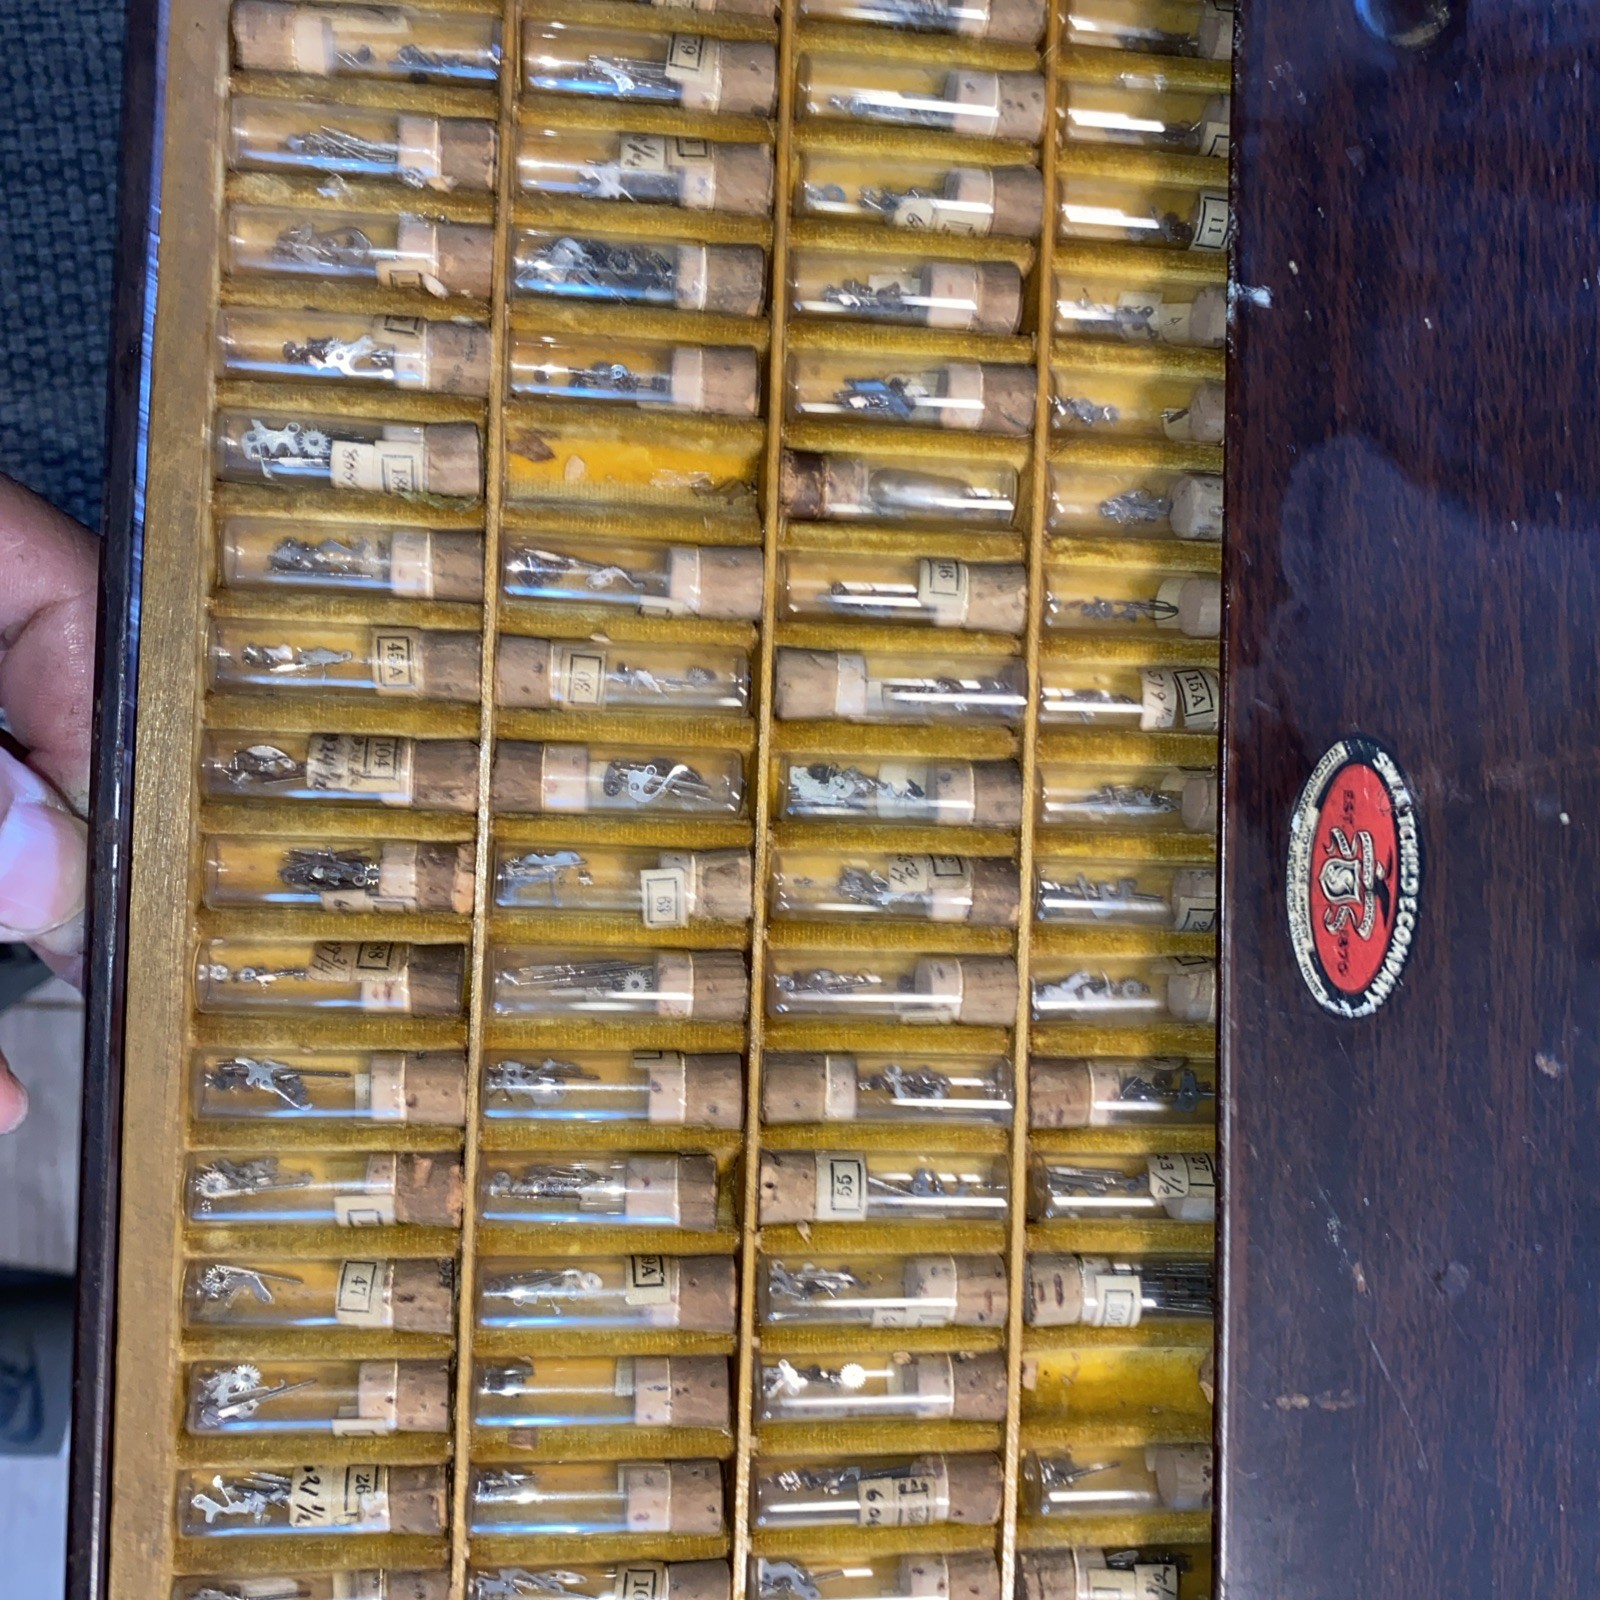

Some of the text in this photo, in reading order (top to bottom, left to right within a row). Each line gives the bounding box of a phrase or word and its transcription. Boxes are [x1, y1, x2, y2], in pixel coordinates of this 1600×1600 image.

[1208, 216, 1225, 234] 11
[387, 642, 404, 678] 45A
[1185, 674, 1206, 708] 15A
[374, 742, 391, 768] 104
[657, 896, 672, 914] 63
[1364, 911, 1417, 1009] COMPANY
[1191, 1156, 1209, 1173] 27
[836, 1174, 853, 1197] 55
[349, 1276, 368, 1297] 47
[354, 1474, 371, 1495] 26
